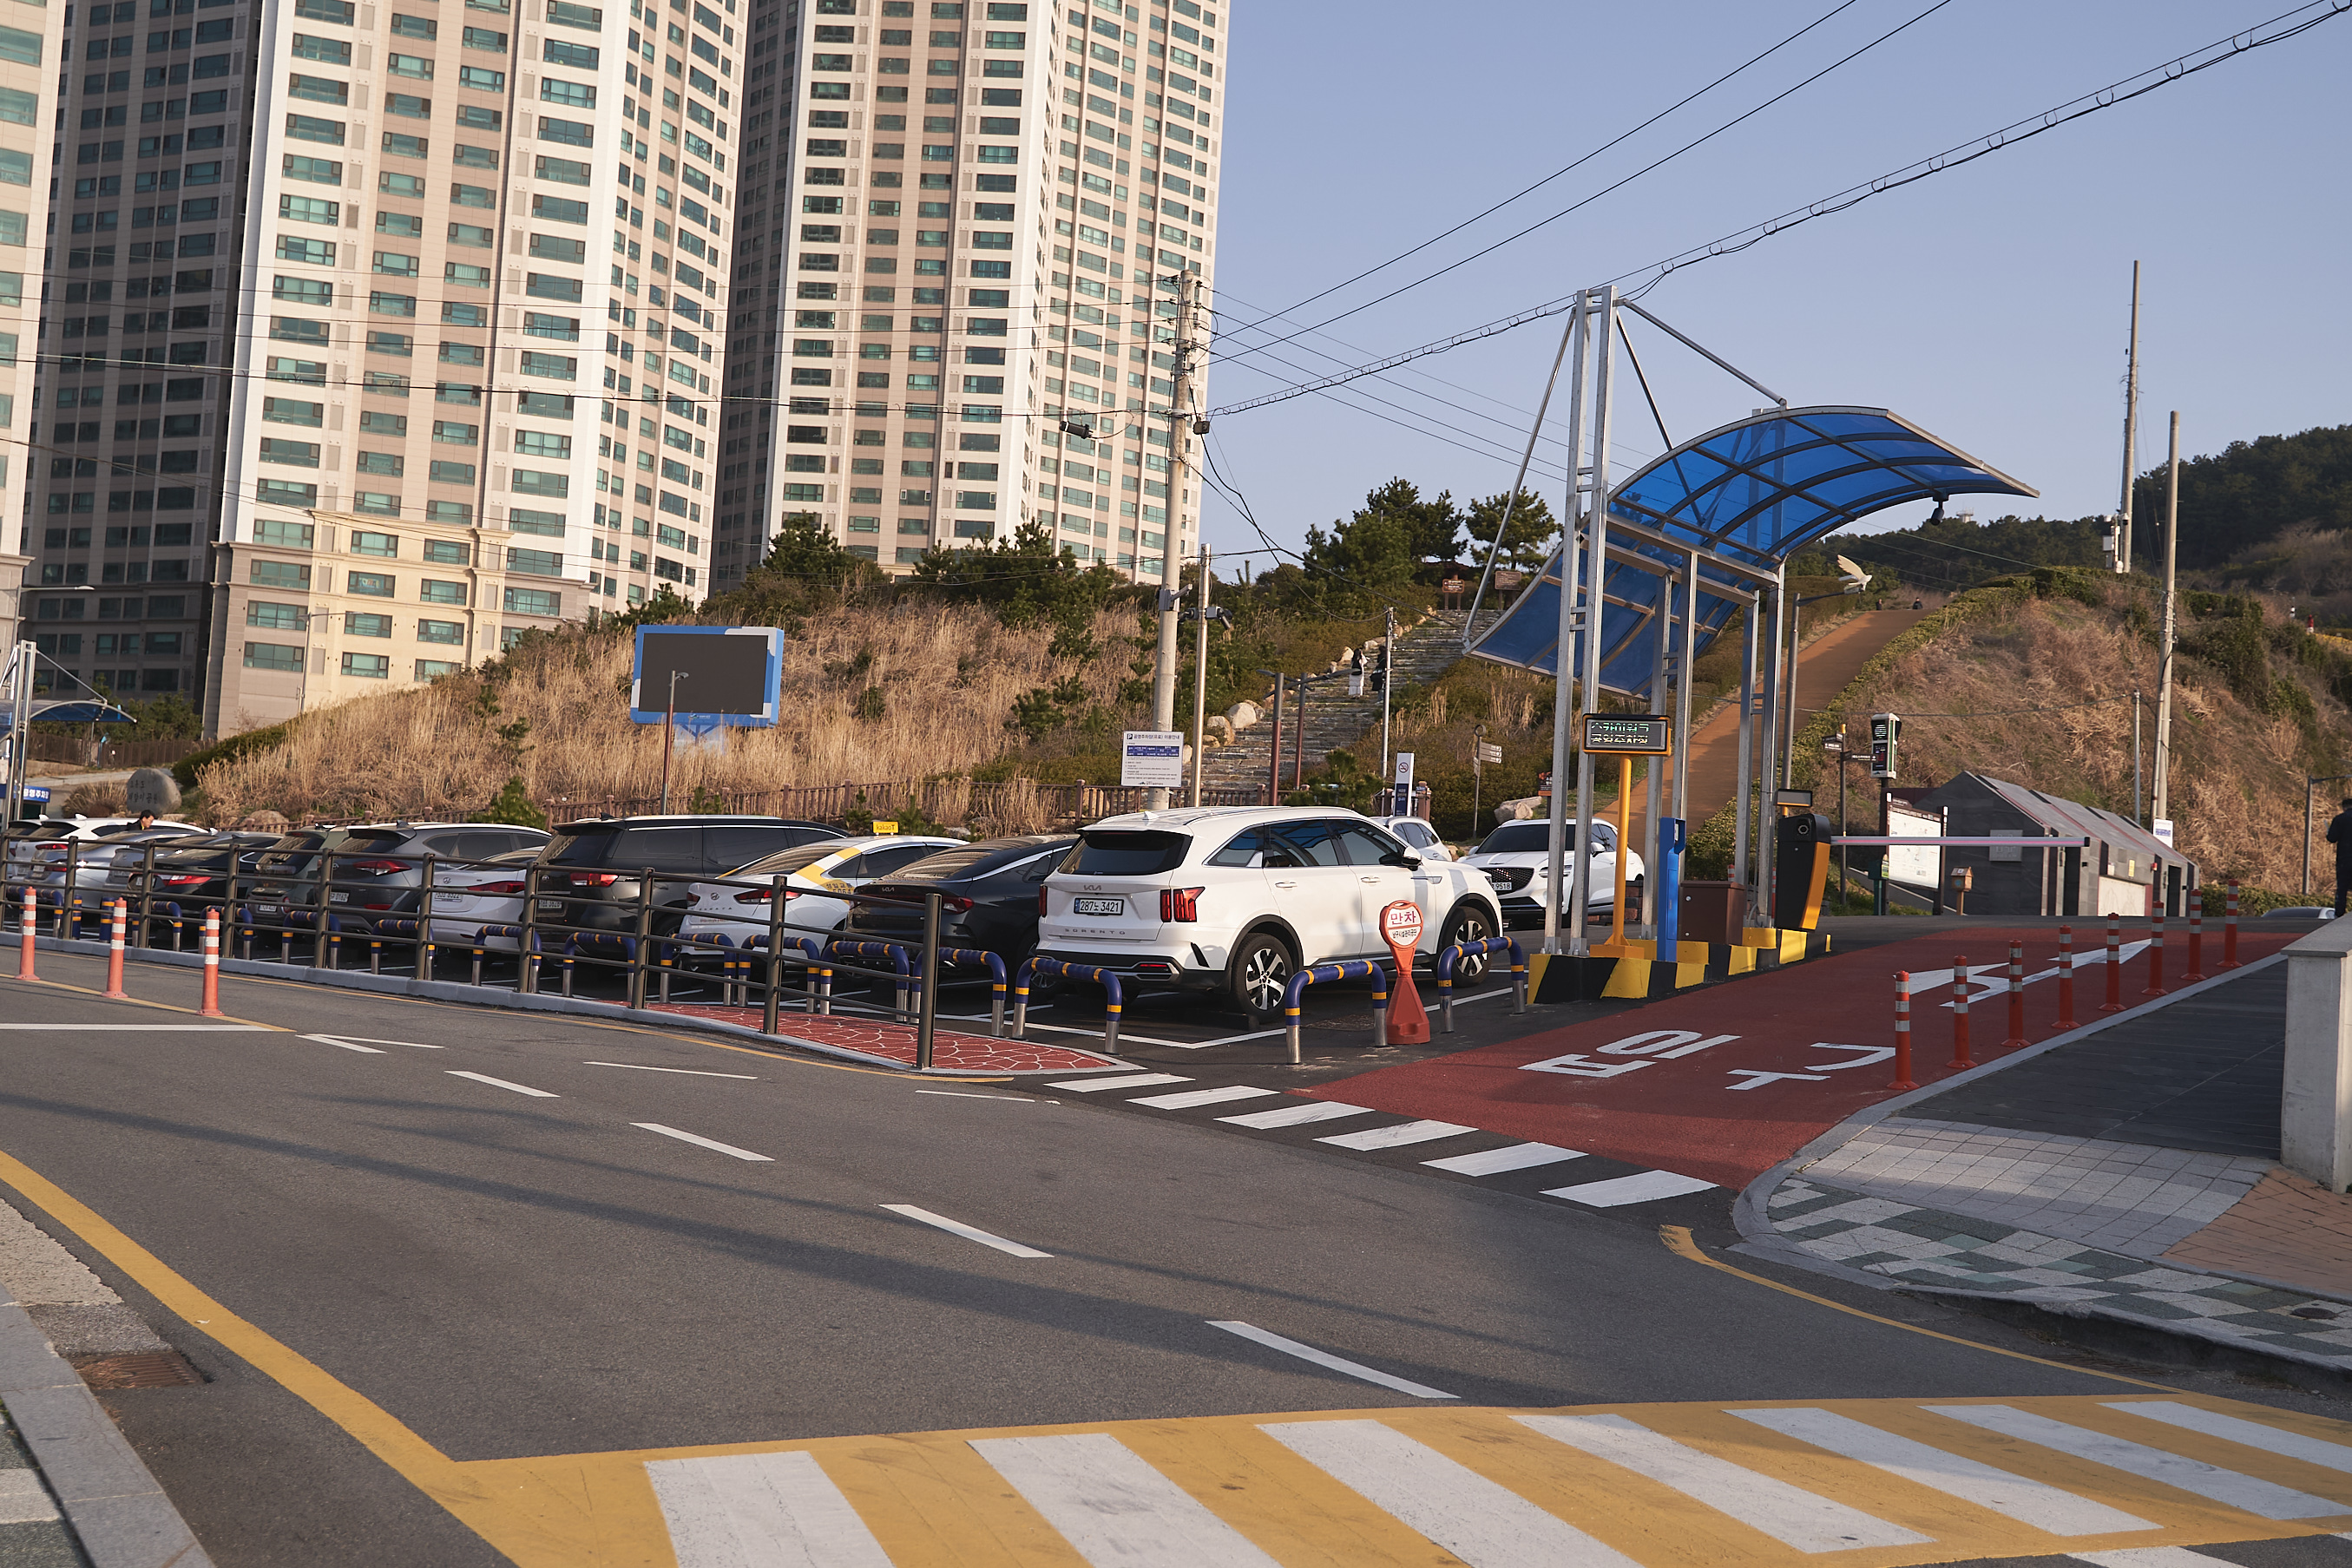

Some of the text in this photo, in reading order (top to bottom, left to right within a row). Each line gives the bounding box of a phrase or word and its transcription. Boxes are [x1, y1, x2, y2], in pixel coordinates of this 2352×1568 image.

[1080, 901, 1119, 912] 287노 3421
[1390, 910, 1416, 925] 만차
